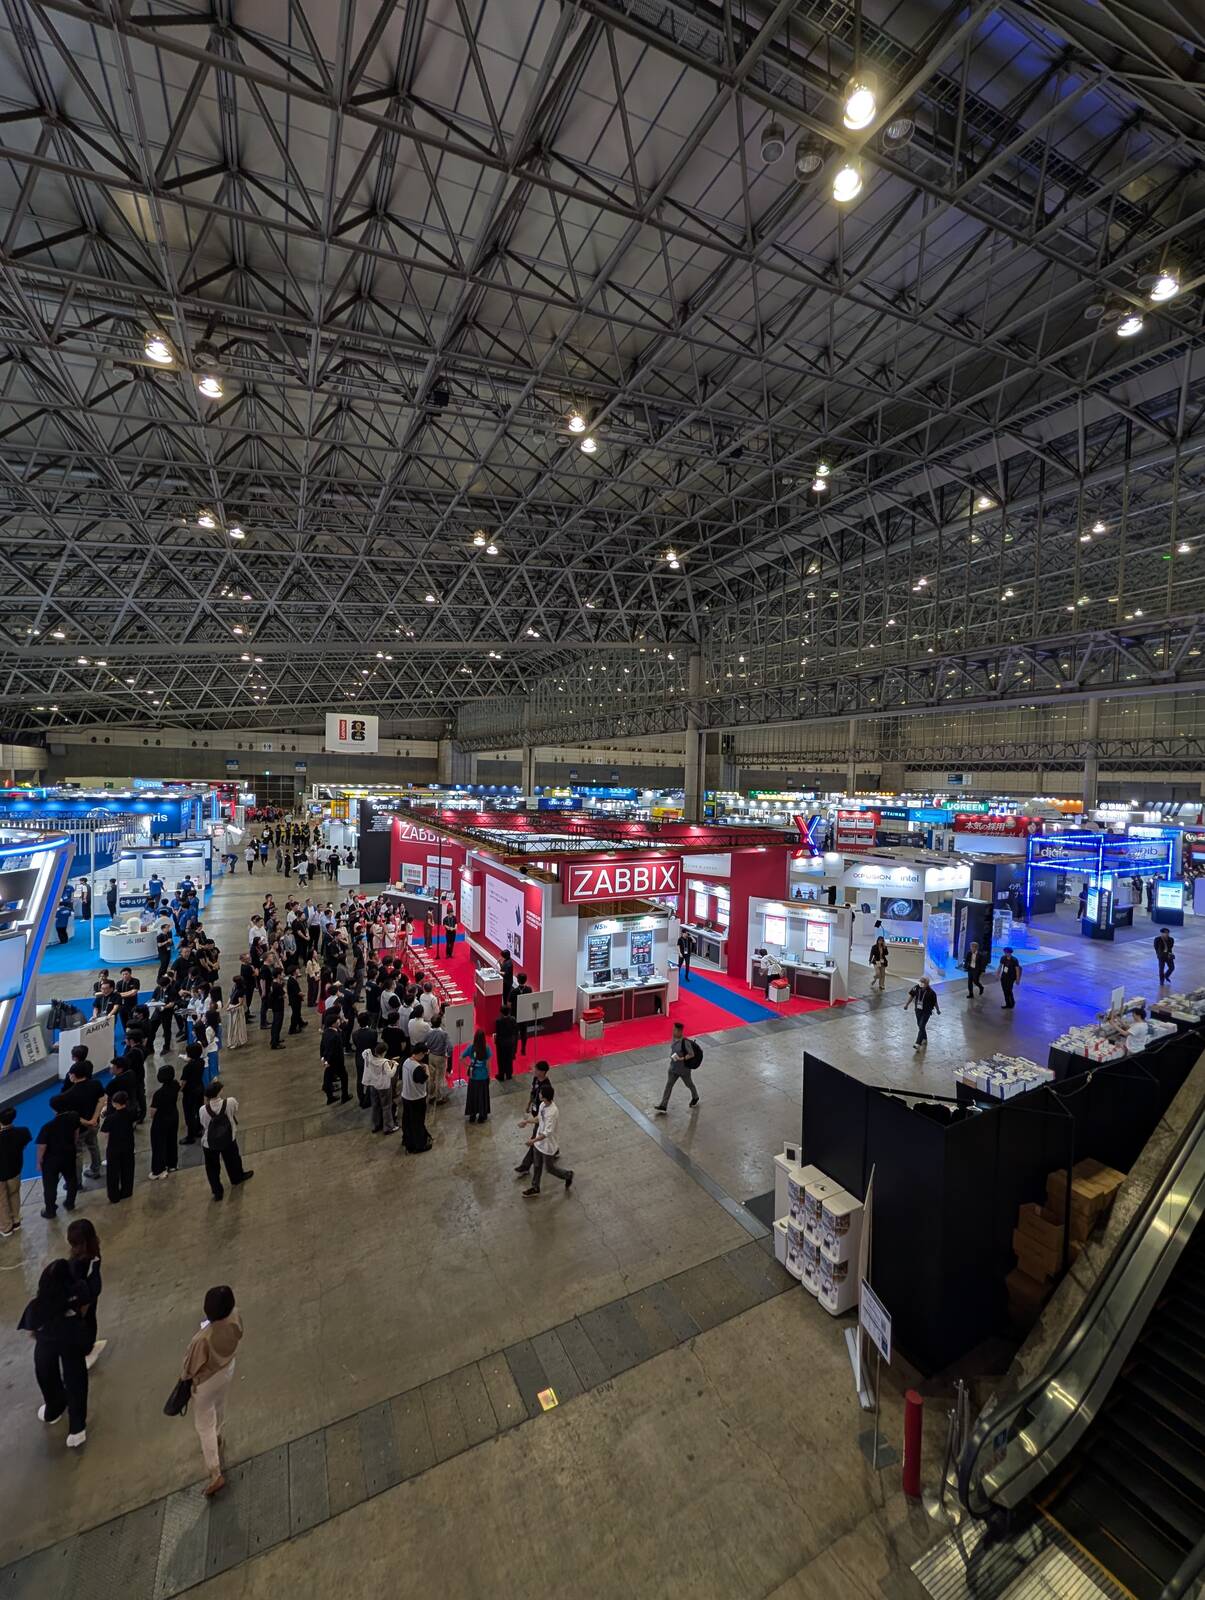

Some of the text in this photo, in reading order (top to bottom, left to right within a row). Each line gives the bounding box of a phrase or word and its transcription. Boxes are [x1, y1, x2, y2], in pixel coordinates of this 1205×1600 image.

[946, 803, 985, 811] UGREEN
[573, 865, 676, 896] ZABBIX
[900, 874, 920, 882] intel
[86, 1022, 109, 1034] AMIYA
